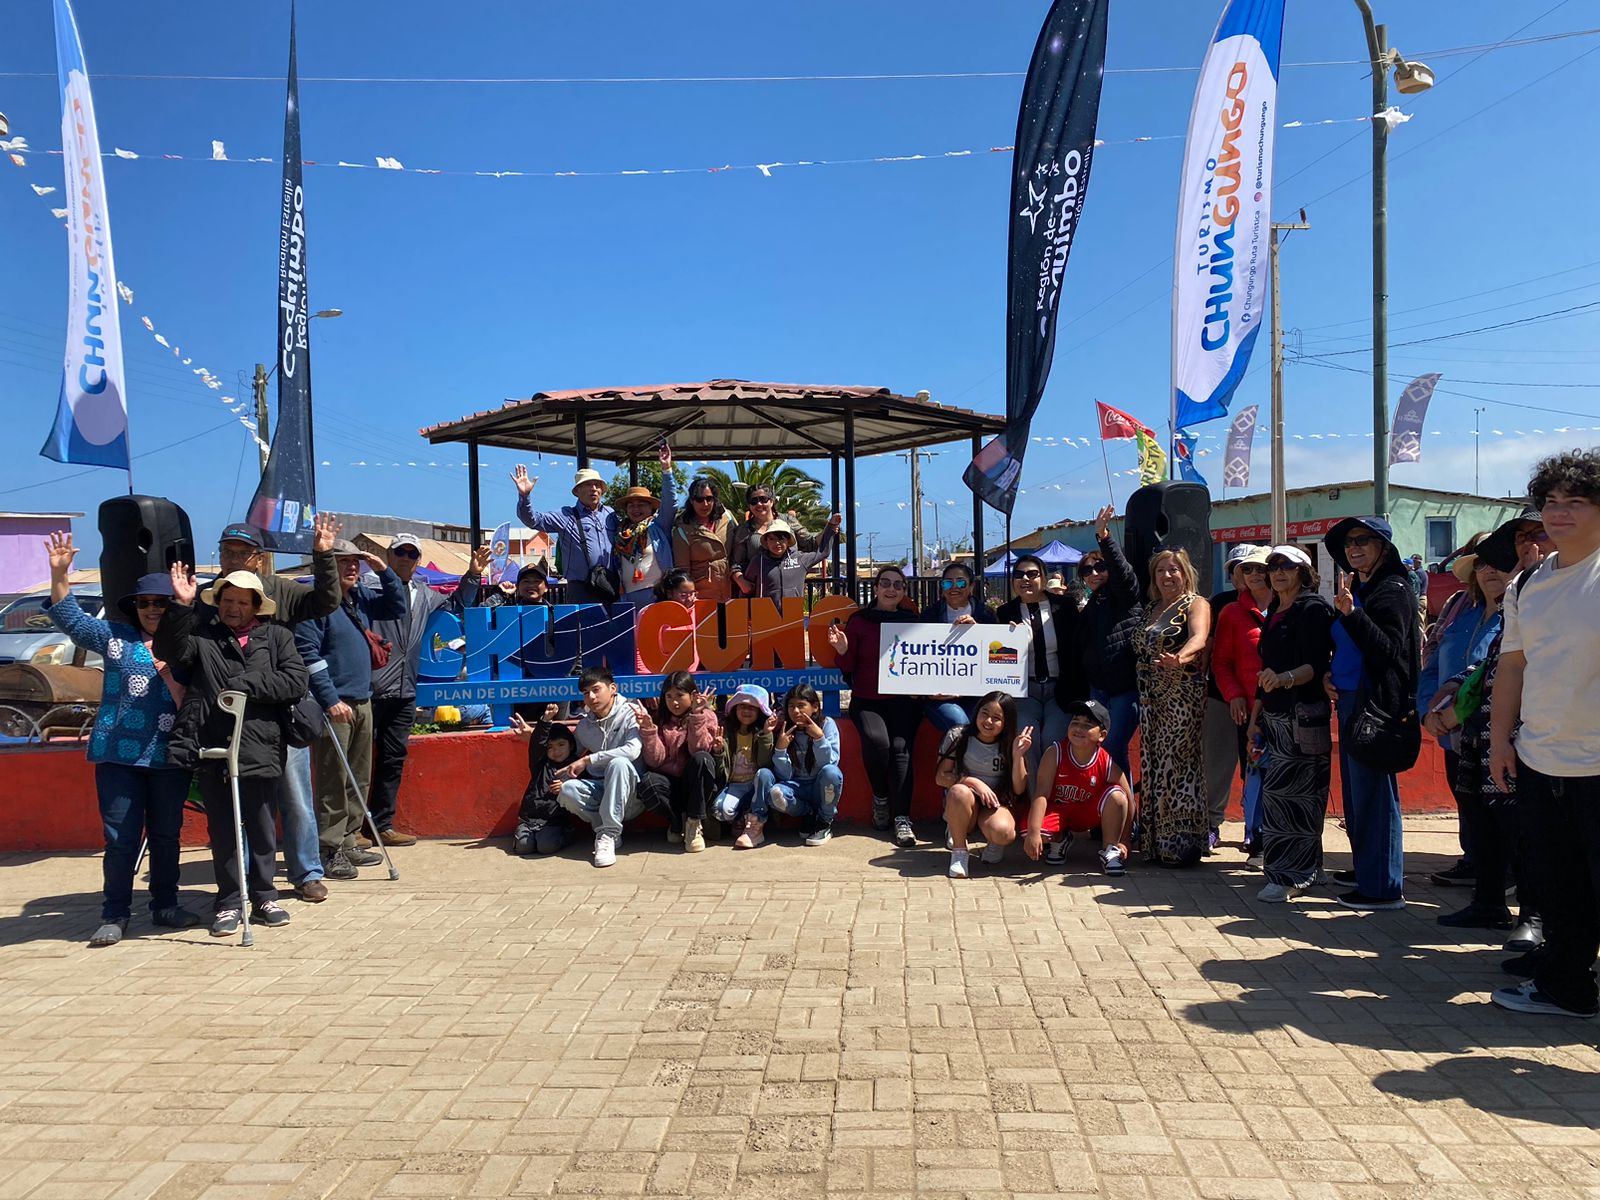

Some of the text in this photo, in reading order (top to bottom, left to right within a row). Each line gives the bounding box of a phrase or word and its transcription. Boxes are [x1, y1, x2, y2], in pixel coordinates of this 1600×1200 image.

[1197, 158, 1216, 275] TURISMO
[1201, 62, 1247, 351] CHUNGUNGO
[1043, 217, 1056, 240] de
[1249, 245, 1258, 264] Ruta
[1243, 265, 1256, 311] Chungungo
[900, 640, 978, 656] turismo
[900, 657, 978, 677] familiar
[434, 688, 472, 701] PLAN
[477, 686, 496, 699] DE
[500, 684, 584, 699] DESARROL
[776, 676, 794, 687] DE
[985, 677, 1021, 685] SERNATUR
